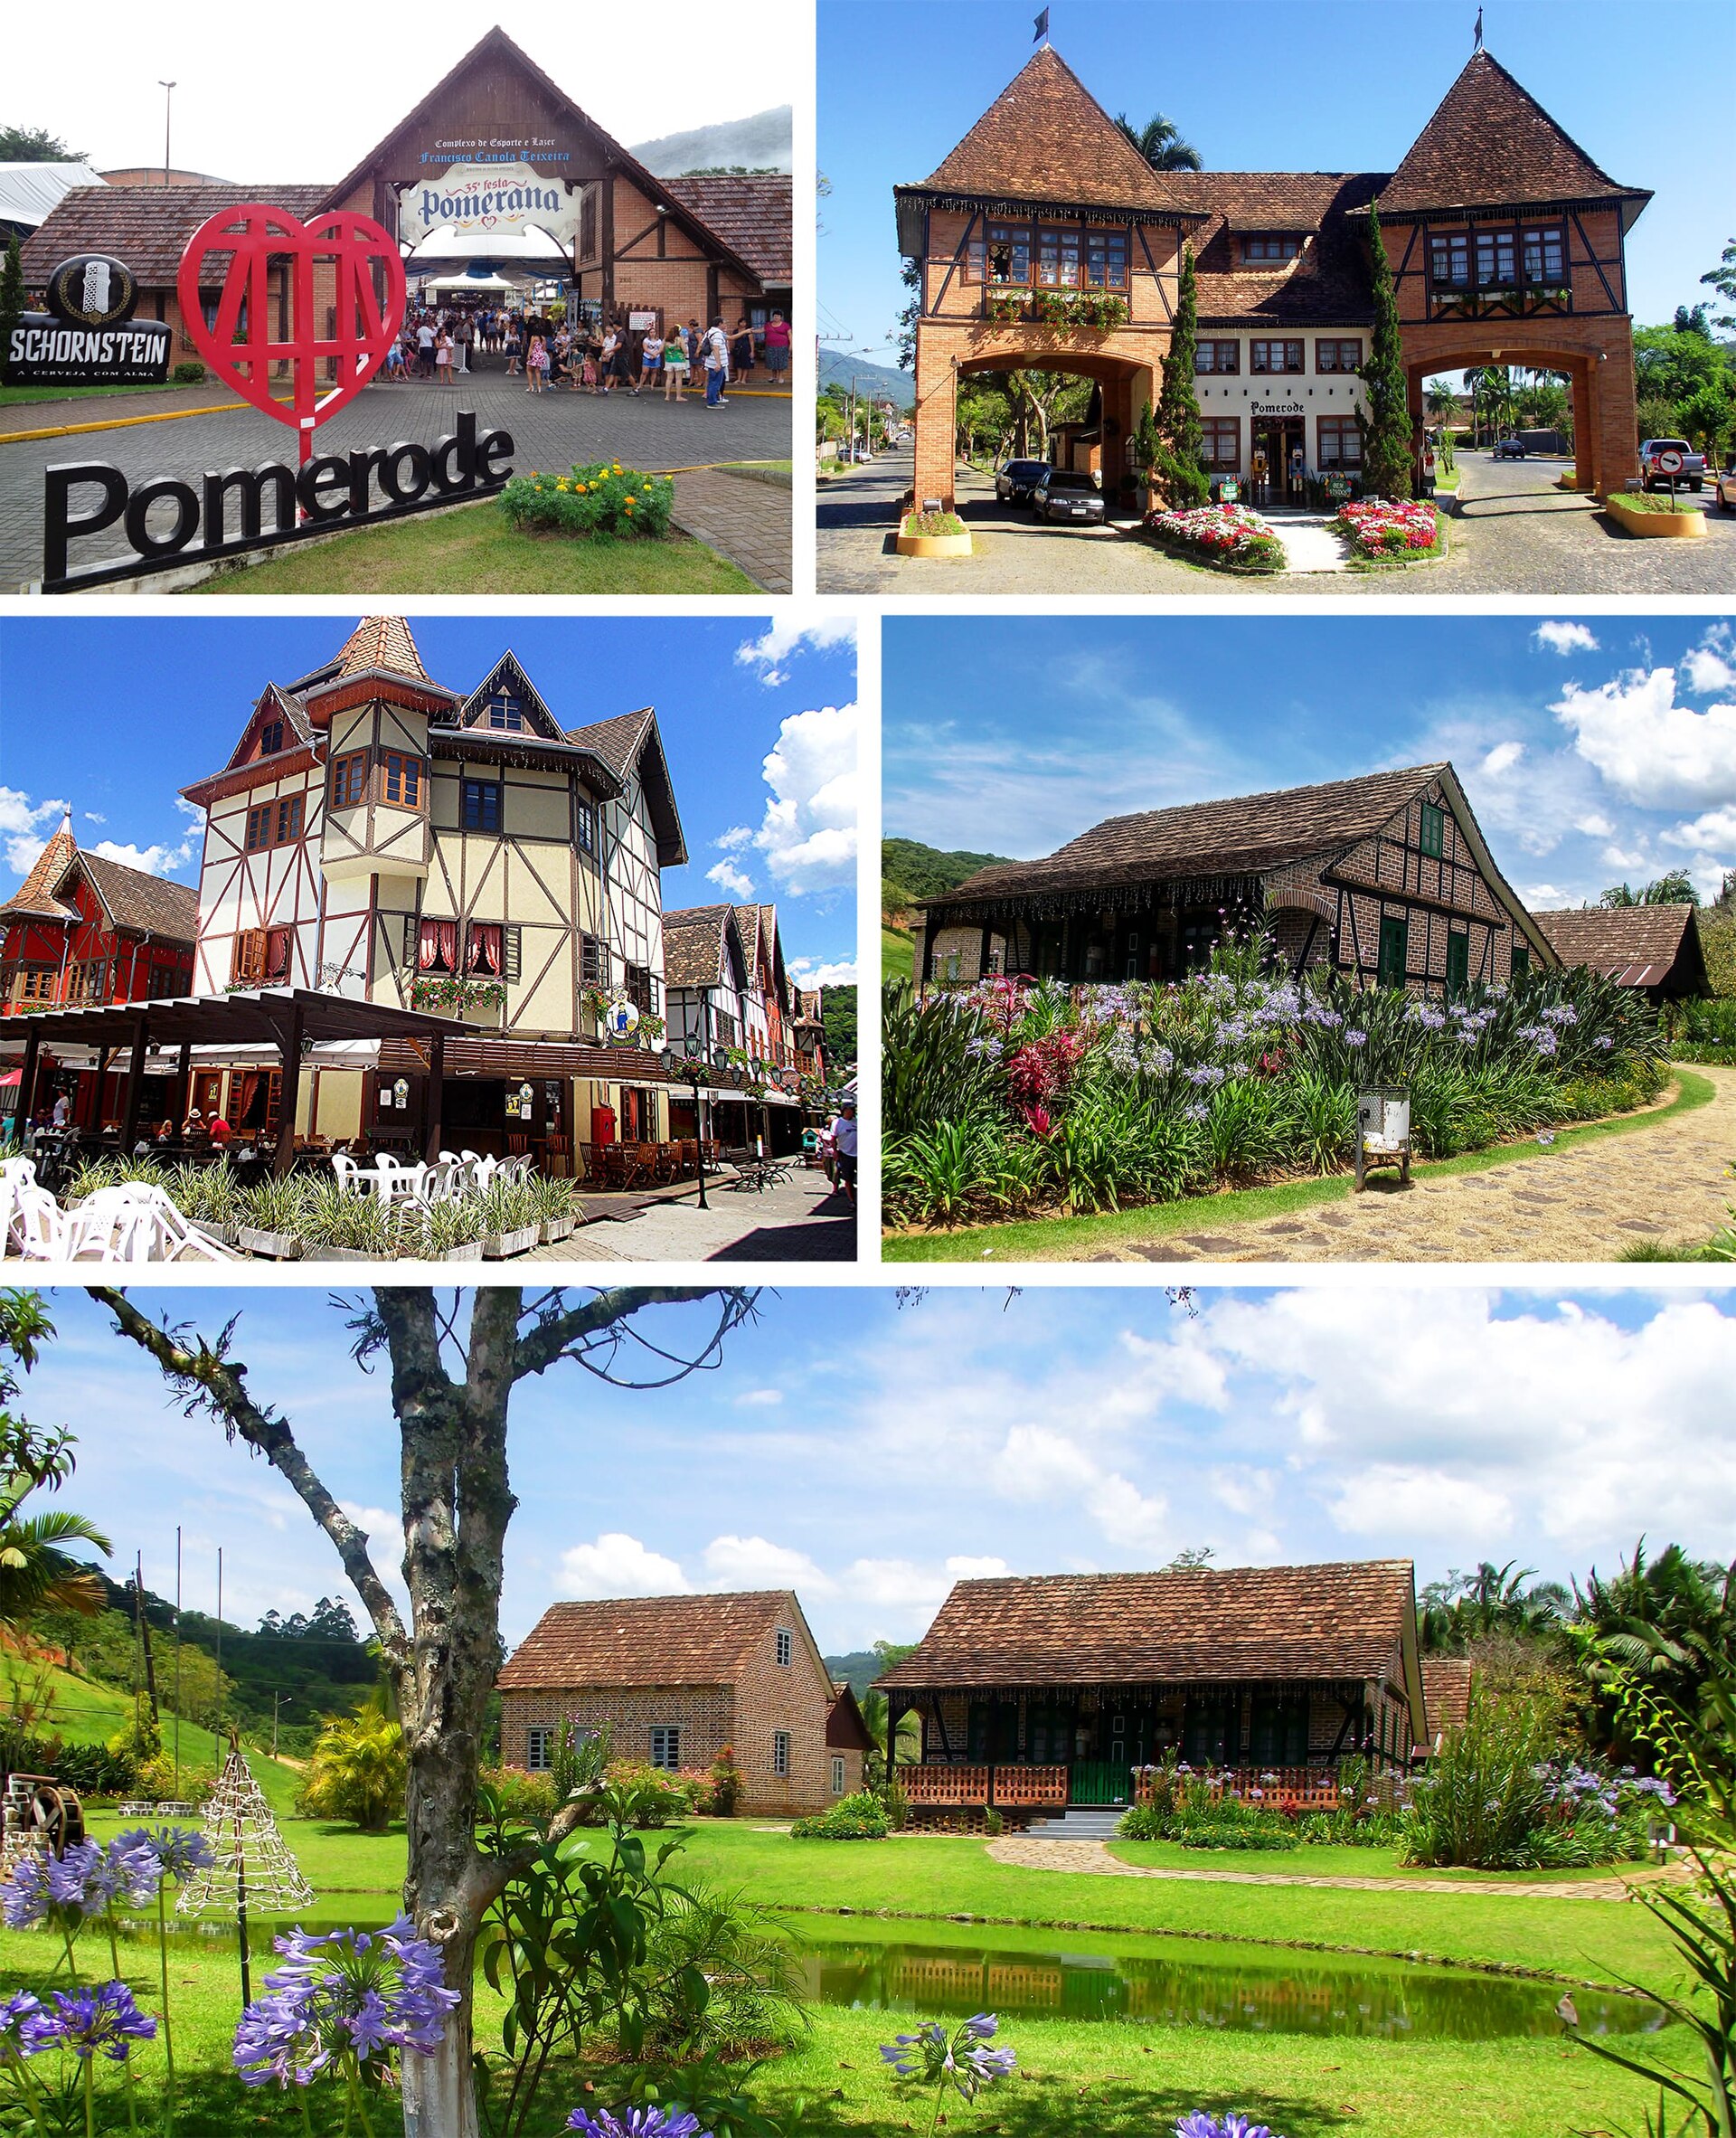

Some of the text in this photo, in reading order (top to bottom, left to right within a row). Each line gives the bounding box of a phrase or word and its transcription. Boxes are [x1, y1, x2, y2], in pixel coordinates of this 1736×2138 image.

[435, 138, 476, 148] Complexo
[477, 138, 486, 147] de
[489, 138, 523, 148] Esporte
[532, 137, 556, 147] Lazer
[419, 150, 571, 164] Francisco Canola Teixeira
[484, 177, 508, 190] festa
[418, 186, 563, 226] Pomerana
[9, 329, 166, 364] SCHORNSTEIN
[1250, 401, 1305, 415] Pomerode
[43, 410, 514, 582] Pomerode
